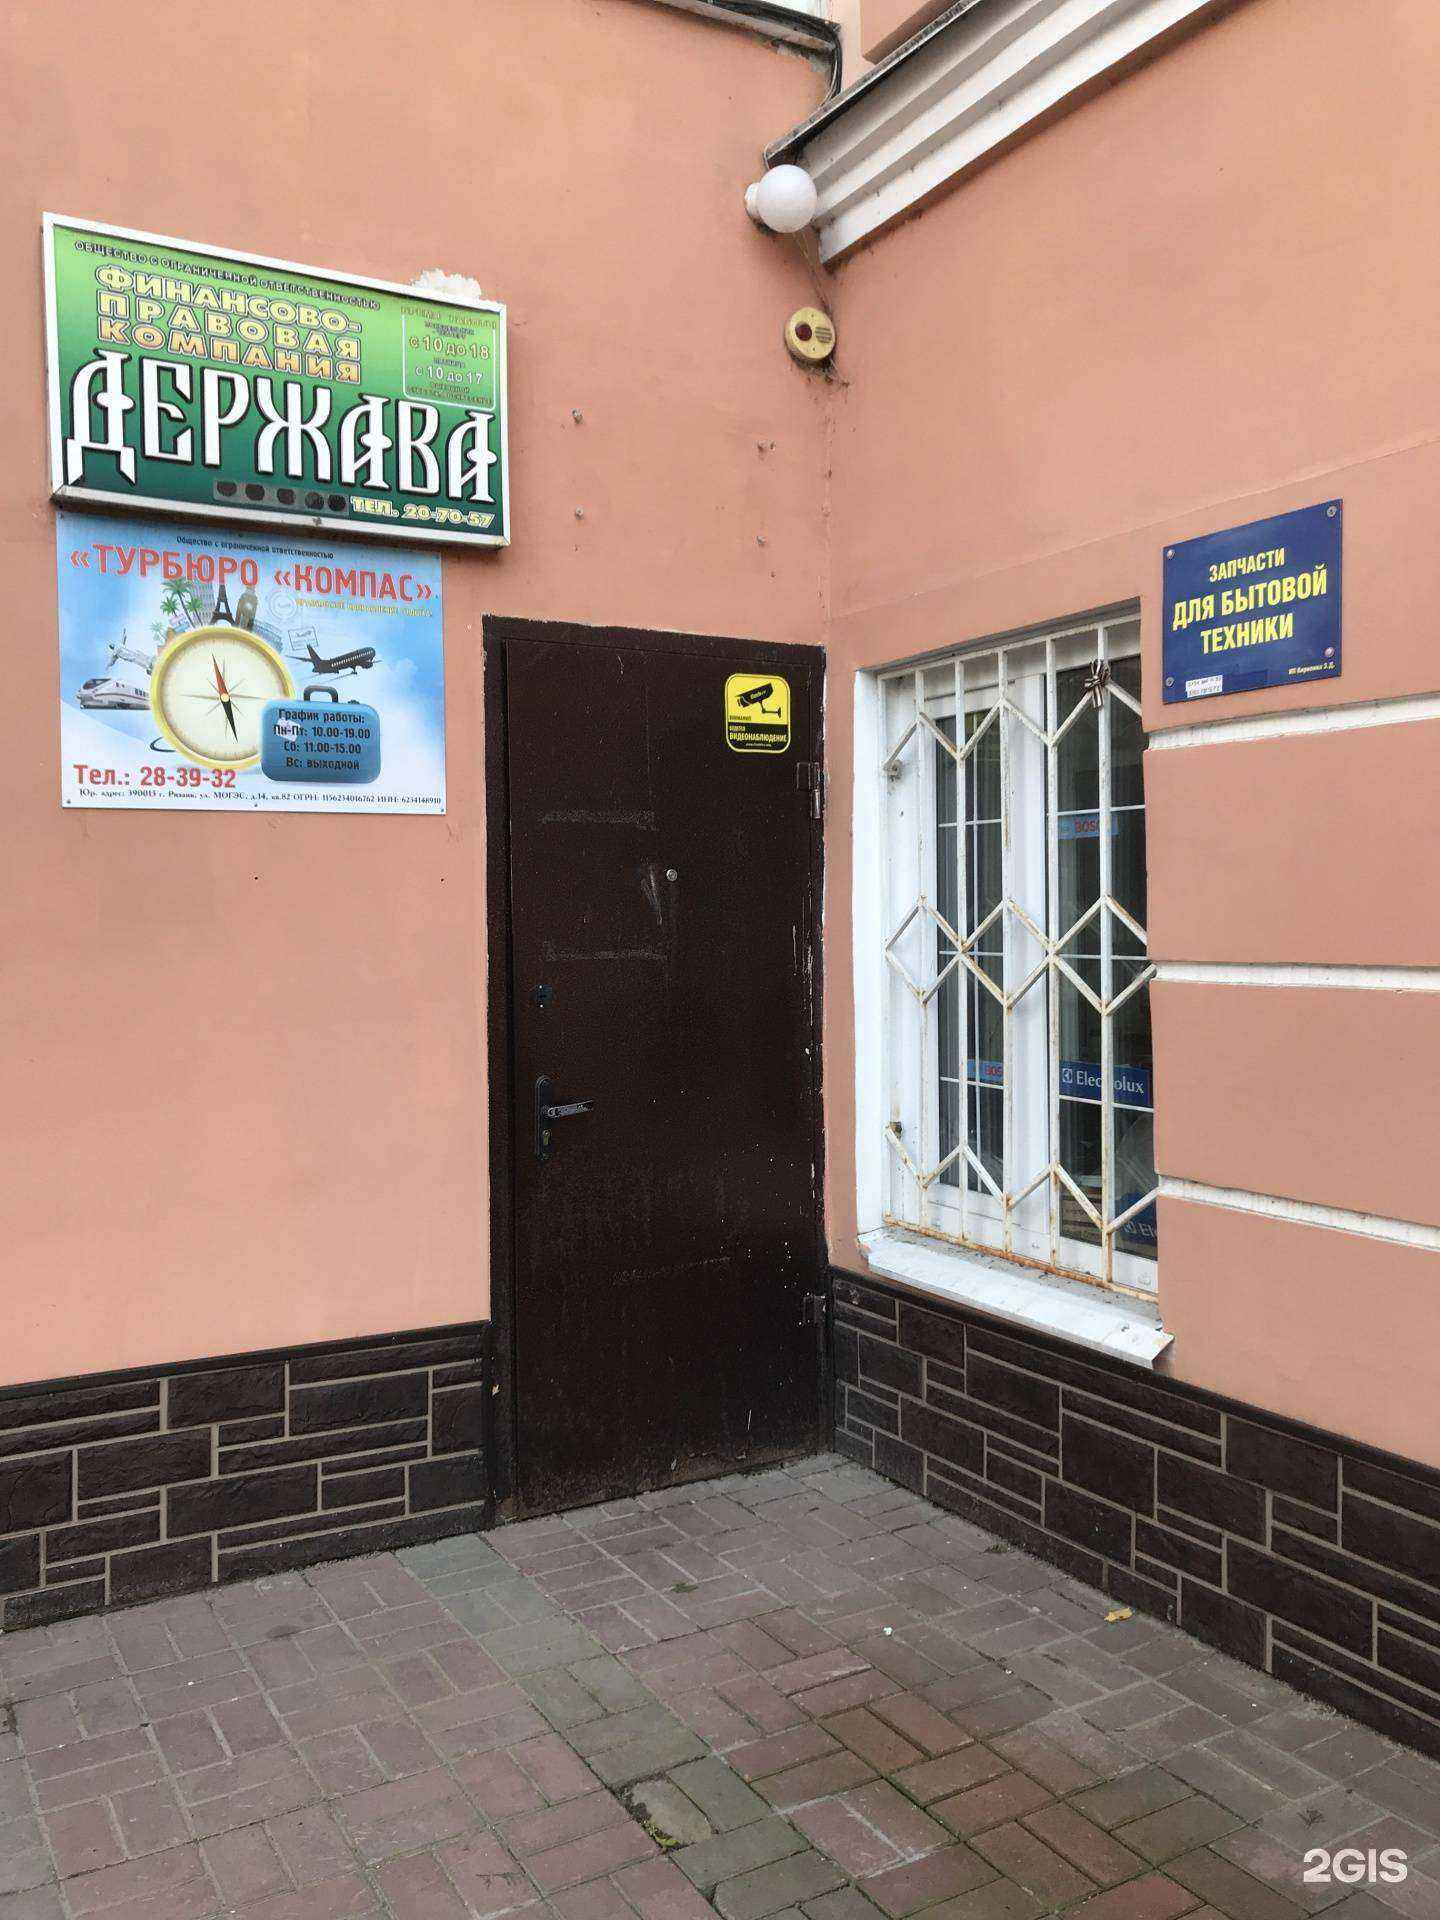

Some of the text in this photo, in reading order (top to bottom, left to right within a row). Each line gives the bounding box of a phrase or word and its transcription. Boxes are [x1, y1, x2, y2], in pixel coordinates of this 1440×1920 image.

[75, 240, 380, 310] ОБЩЕСТВО С ОГРАНИЧЕННОЙ ОТВЕТСТВЕННОСТЬЮ
[95, 264, 362, 334] ФИНАНСОВО-
[97, 291, 361, 361] ПРАВОВАЯ
[97, 317, 361, 385] КОМПАНИЯ
[423, 335, 443, 352] 10
[470, 342, 489, 360] 18
[426, 365, 444, 380] 10
[466, 370, 483, 385] 17
[63, 348, 500, 504] ДЕРЖАВА
[350, 495, 496, 528] ТЕЛ. 20-70-57
[176, 535, 213, 547] Общество
[70, 543, 259, 587] «ТУРБЮРО
[273, 563, 432, 602] «КОМПАС»
[1209, 547, 1285, 583] ЗАПЧАСТИ
[1172, 563, 1328, 632] ДЛЯ БЫТОВОЙ
[1200, 612, 1294, 655] ТЕХНИКИ
[273, 724, 371, 739] Пн-Пт: 10.00-19.00
[278, 708, 365, 724] График работы:
[283, 741, 362, 754] Сб: 11.00-15.00
[286, 757, 360, 770] Вс: выходной
[73, 764, 237, 789] Тел.: 28-39-32
